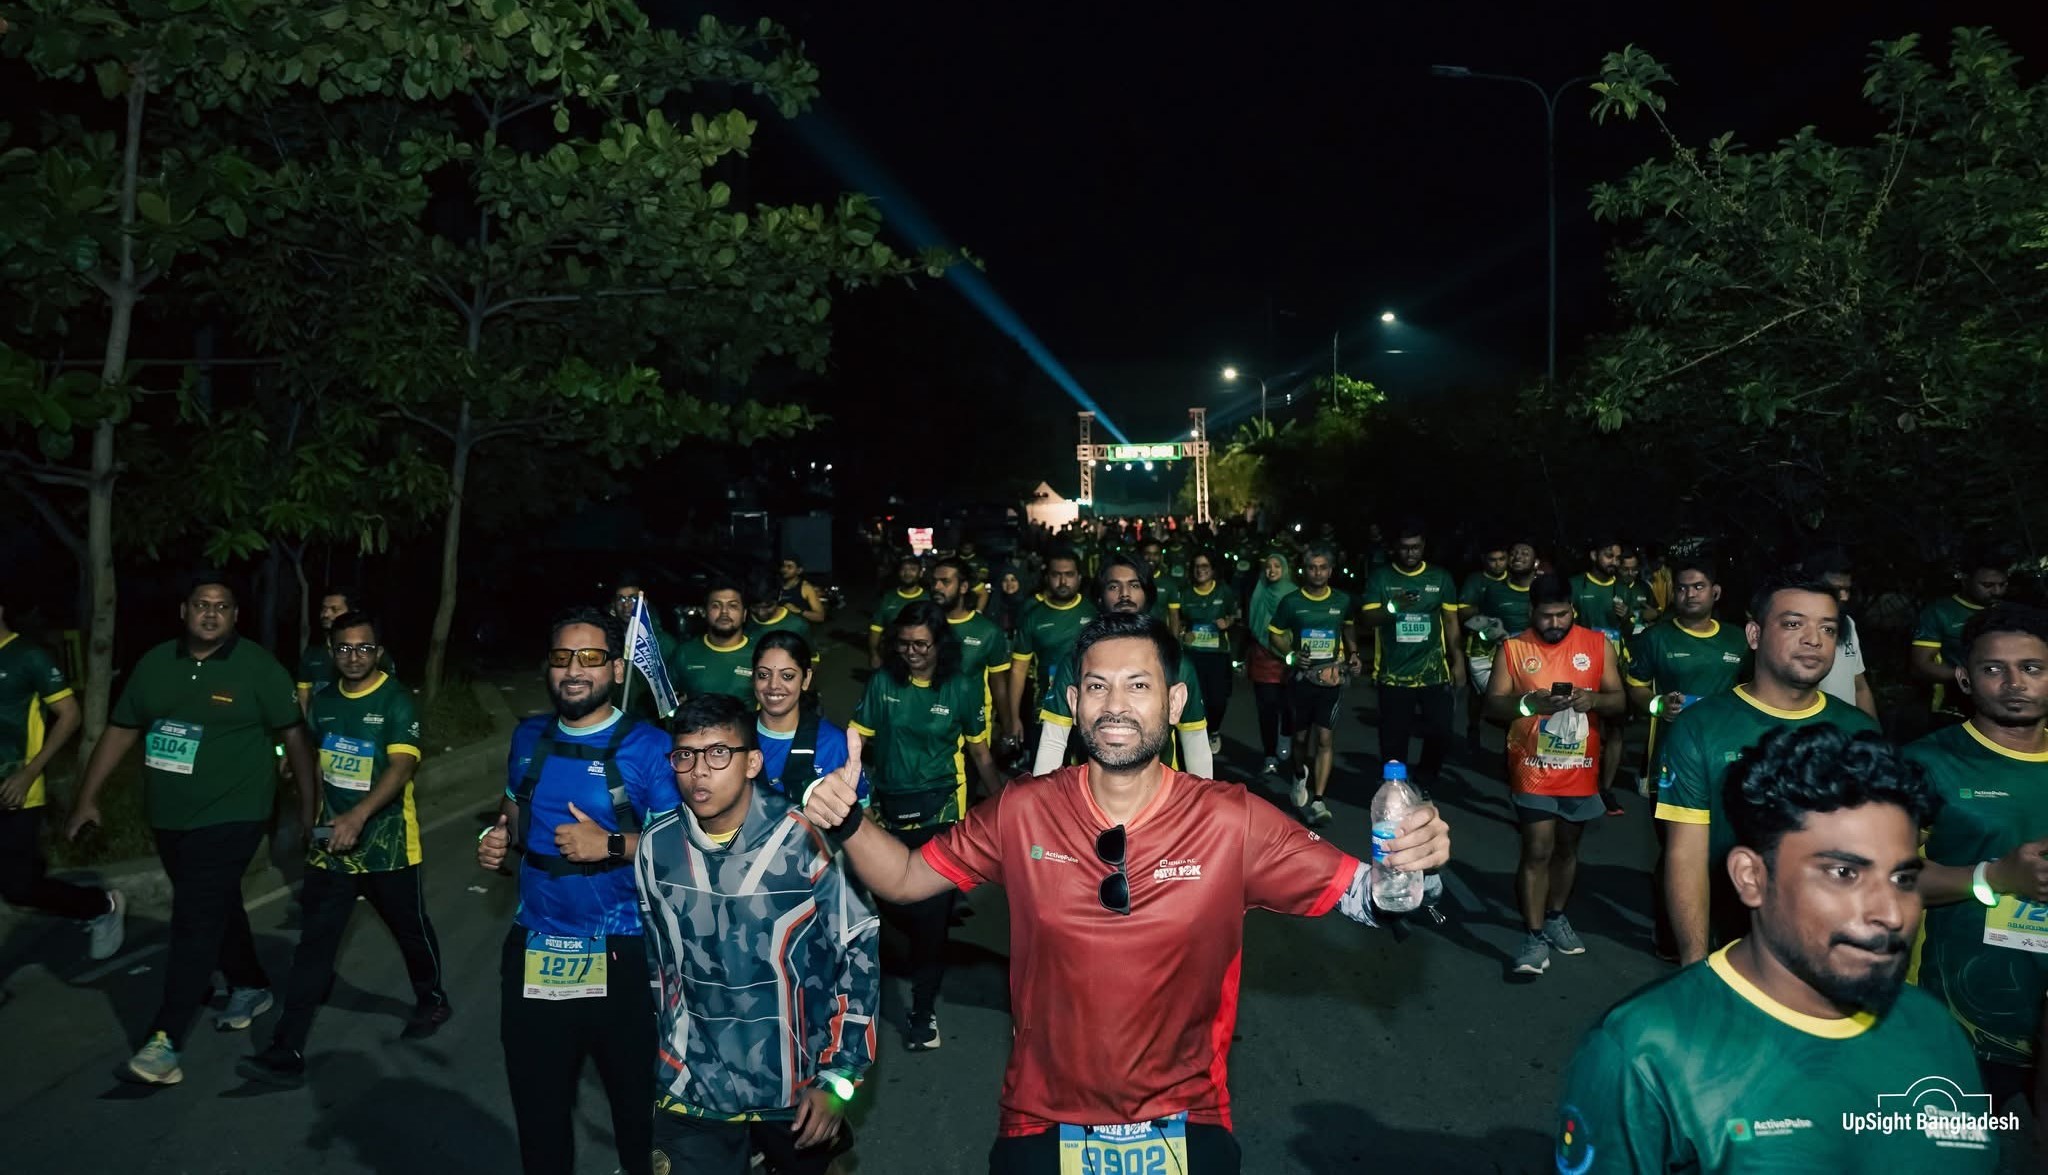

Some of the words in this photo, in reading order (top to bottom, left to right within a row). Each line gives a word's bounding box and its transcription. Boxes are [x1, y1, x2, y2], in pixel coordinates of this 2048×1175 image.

[152, 735, 187, 755] 5104
[329, 754, 361, 773] 7121
[1045, 851, 1079, 863] ActivePulse
[2014, 898, 2048, 922] 72
[540, 956, 594, 977] 1277
[1081, 1146, 1167, 1175] 9902
